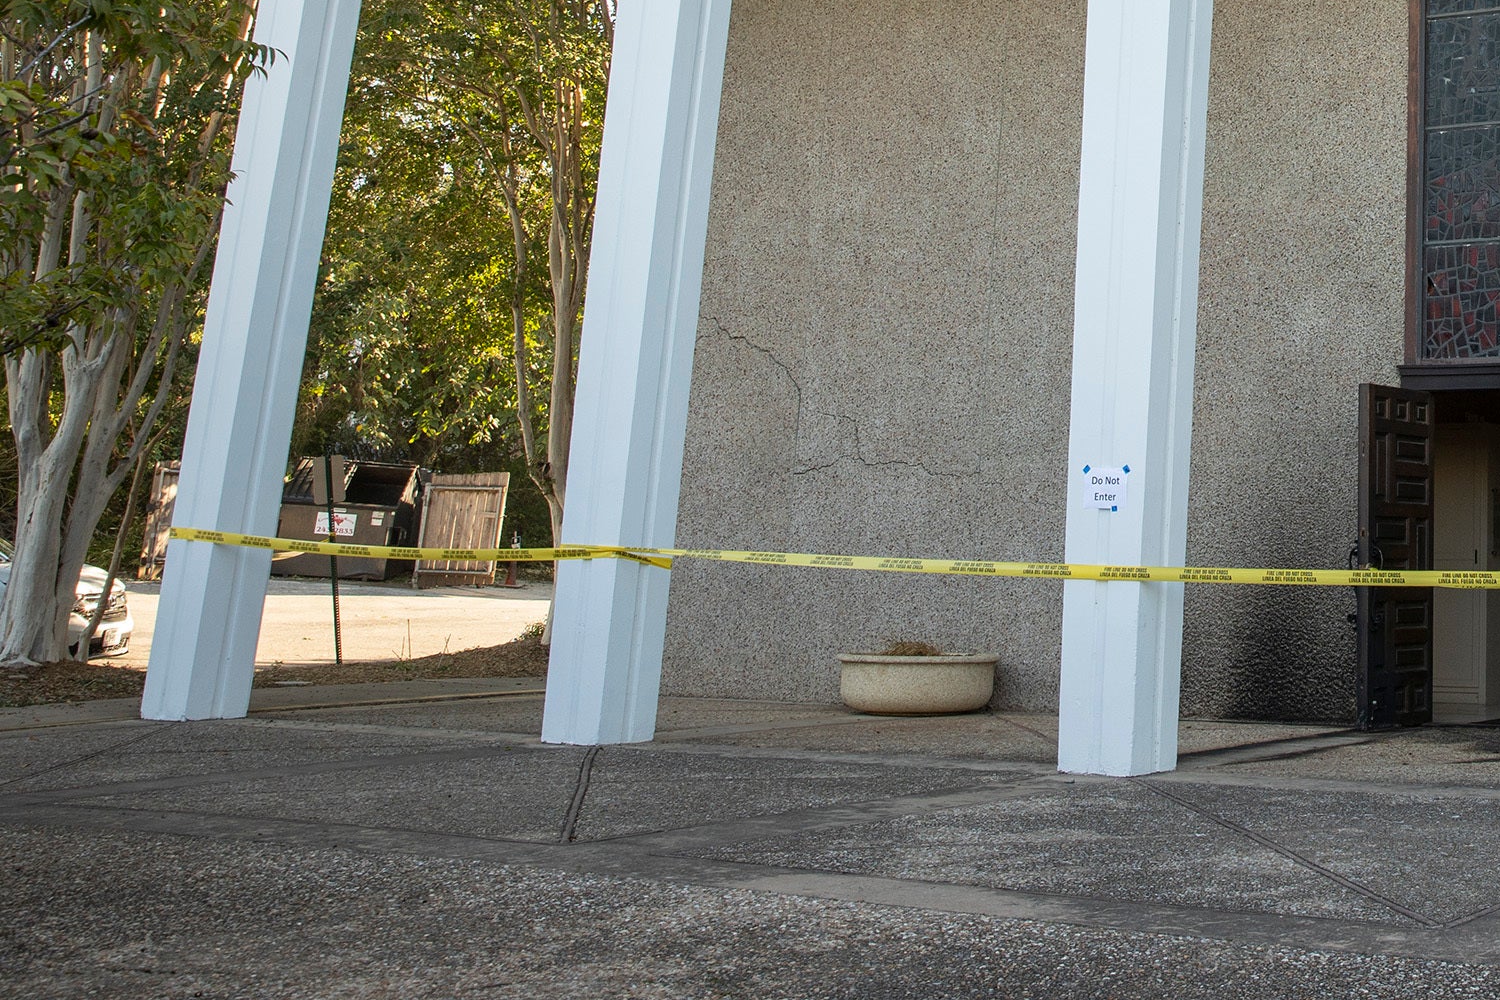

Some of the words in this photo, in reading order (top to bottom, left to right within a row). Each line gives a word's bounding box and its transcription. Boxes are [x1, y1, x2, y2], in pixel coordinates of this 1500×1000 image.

[1092, 476, 1103, 485] Do
[1105, 476, 1120, 485] Not
[1094, 493, 1116, 501] Enter
